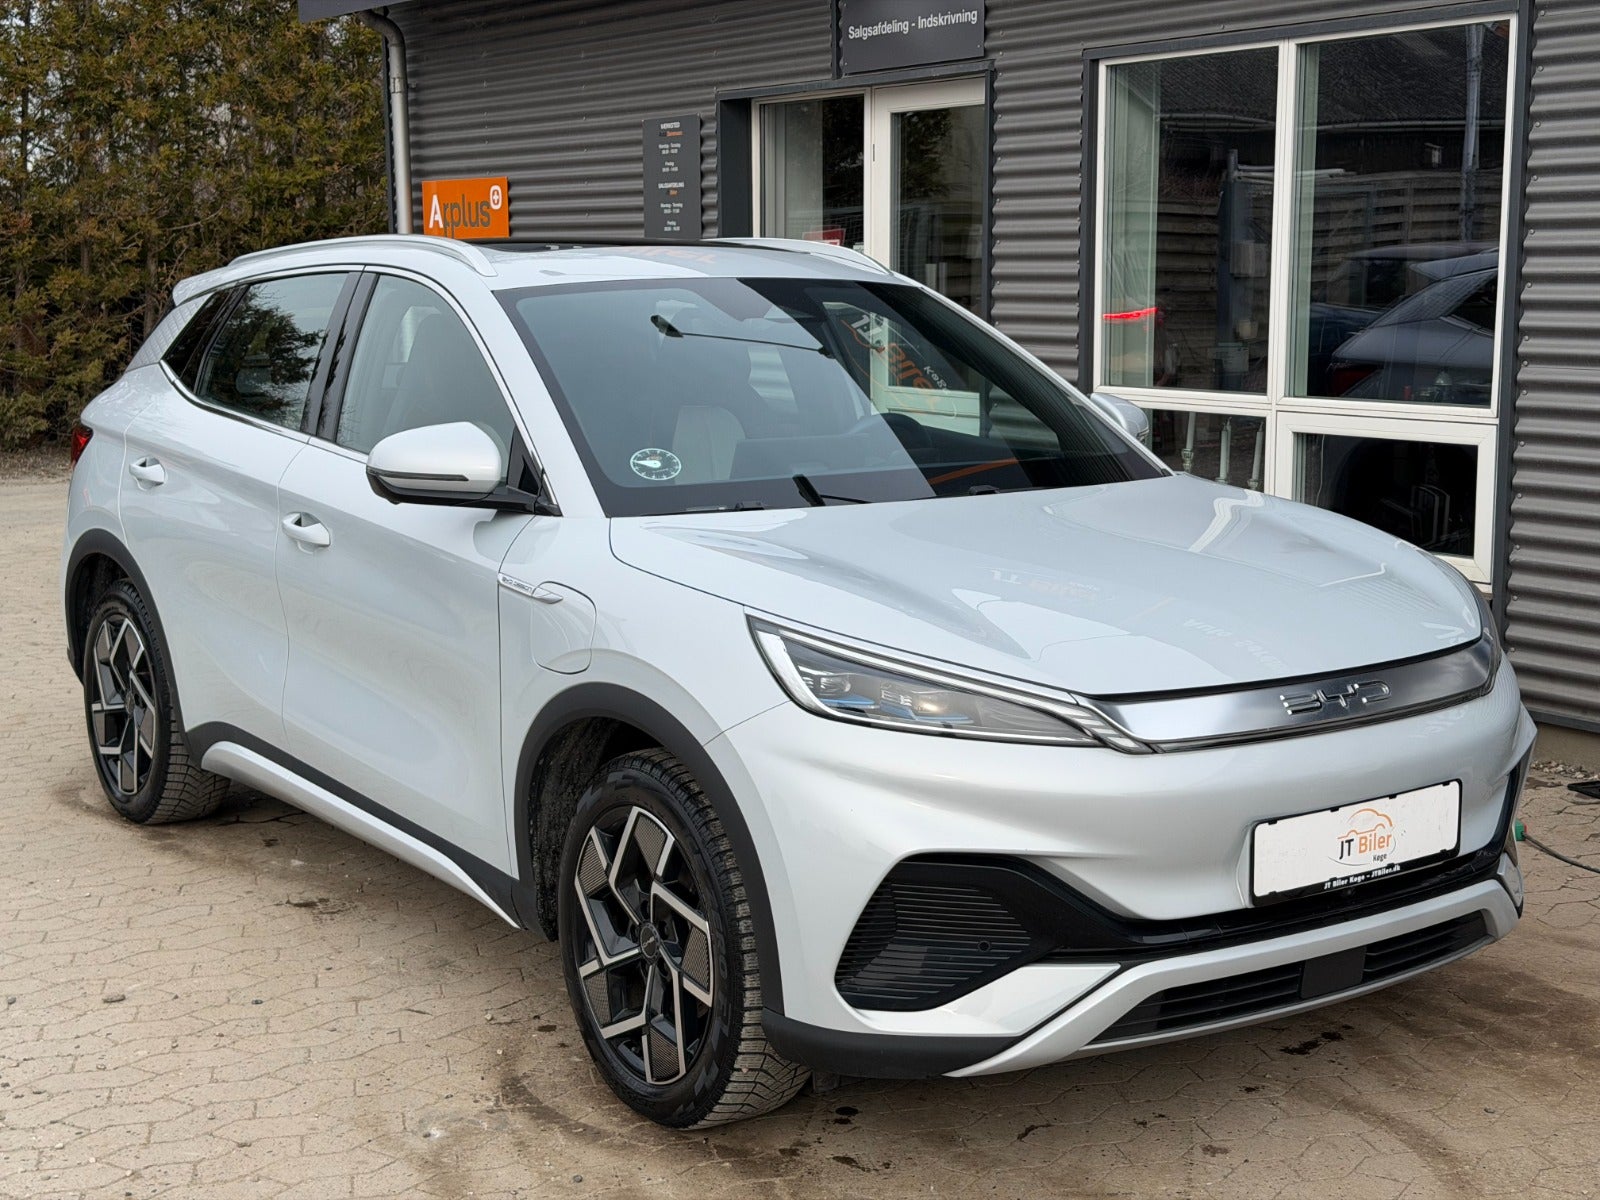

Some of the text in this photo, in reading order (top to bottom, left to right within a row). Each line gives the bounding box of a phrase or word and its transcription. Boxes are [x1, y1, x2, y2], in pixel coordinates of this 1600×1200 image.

[848, 19, 909, 40] Salgsafdeling
[918, 9, 978, 29] Indskrivning
[1279, 680, 1391, 715] BYD
[1339, 832, 1392, 860] JT Biler
[1324, 881, 1331, 890] JT
[1332, 878, 1348, 888] Biler
